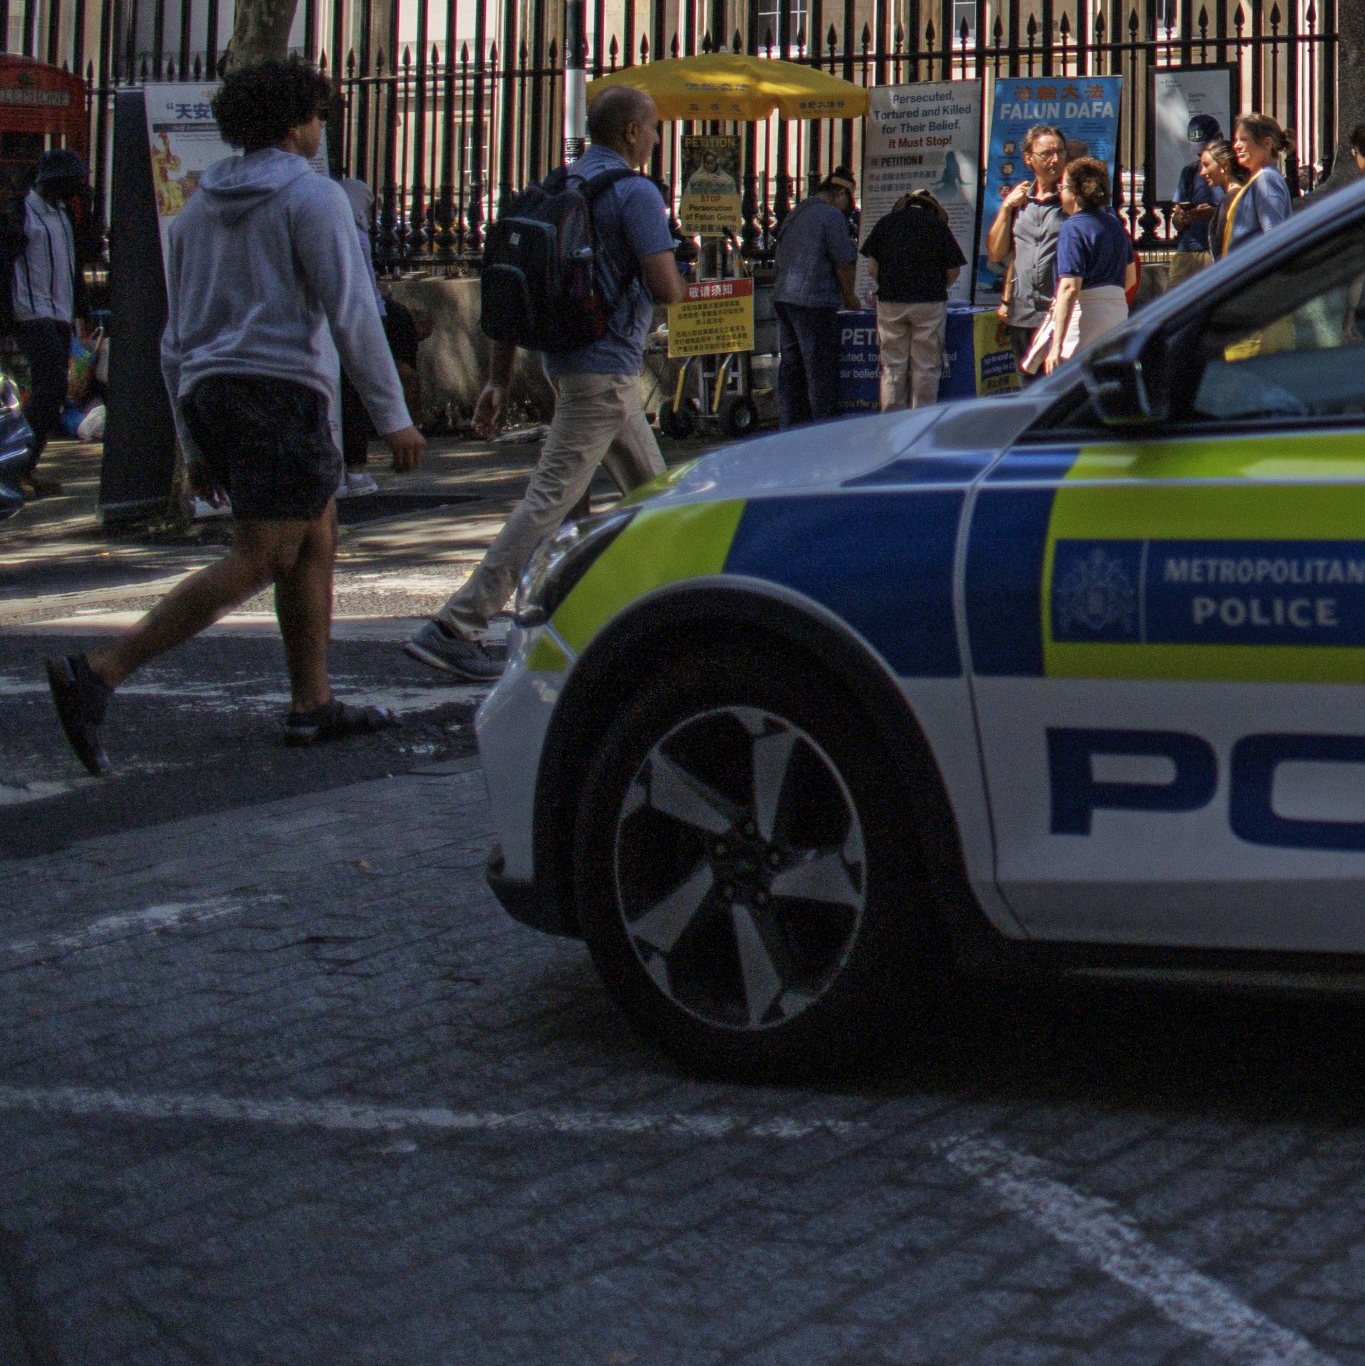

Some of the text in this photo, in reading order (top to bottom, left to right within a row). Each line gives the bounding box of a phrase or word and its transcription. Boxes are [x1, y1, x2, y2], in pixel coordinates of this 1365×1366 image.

[893, 90, 954, 104] Persecuted,
[874, 104, 972, 120] Tortured and Killed
[1000, 102, 1115, 120] FALUN DAFA
[882, 119, 961, 134] for Their Belief.
[684, 138, 736, 148] PETITION
[888, 135, 952, 148] It Must Stop!
[881, 156, 917, 166] PETITION
[700, 195, 722, 203] STOP
[717, 214, 736, 222] Gong
[688, 284, 733, 298] 敬请须知
[1191, 597, 1339, 627] POLICE
